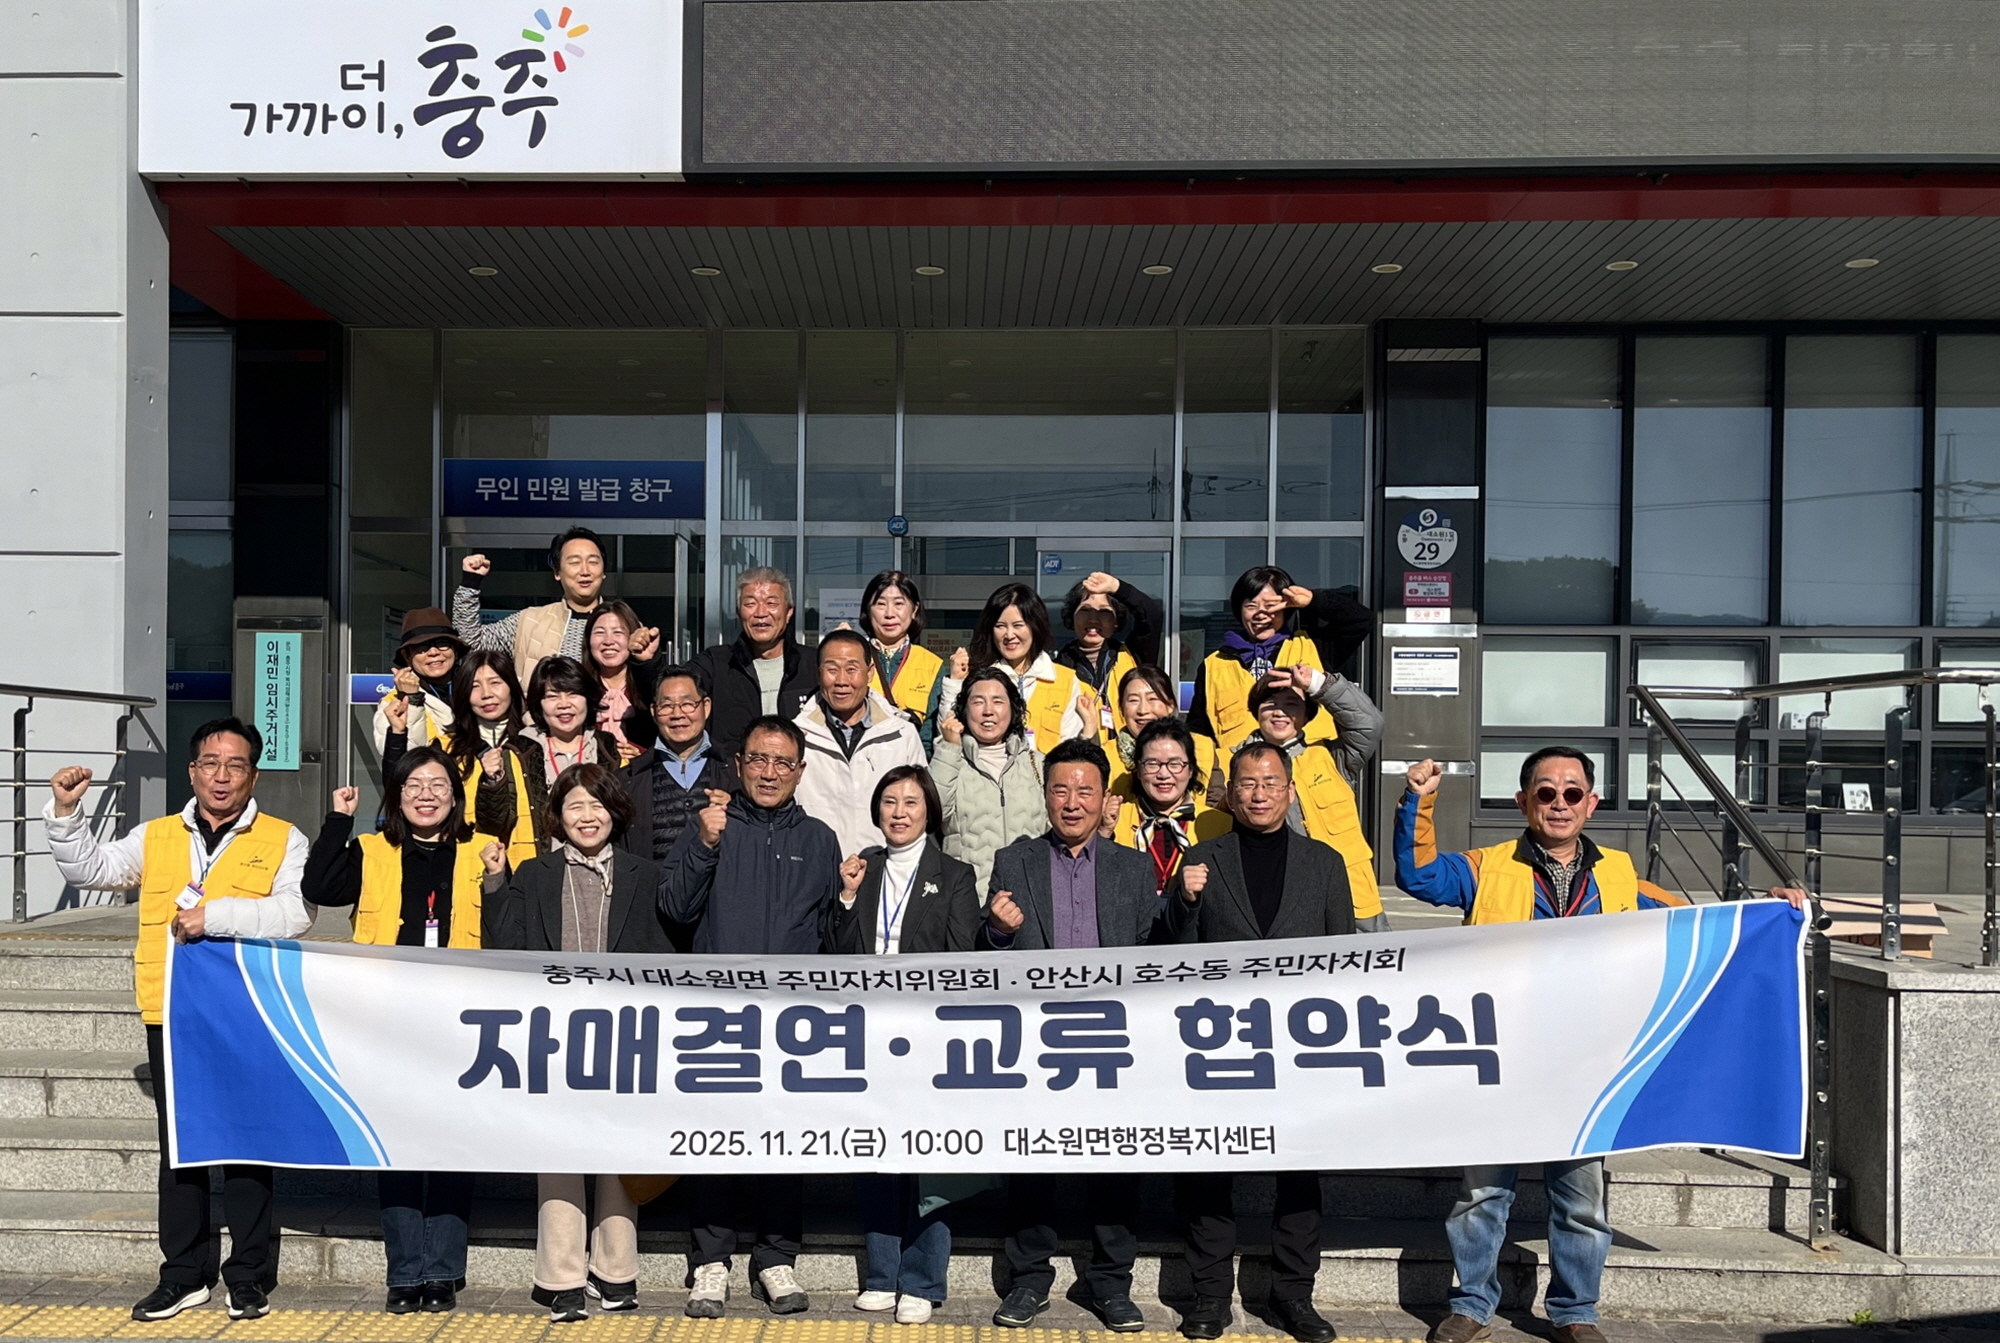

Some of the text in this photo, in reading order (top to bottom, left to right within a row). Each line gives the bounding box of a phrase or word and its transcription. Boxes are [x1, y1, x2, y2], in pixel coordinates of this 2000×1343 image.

[230, 25, 559, 159] 가까이, 충주
[340, 59, 385, 92] 더
[475, 477, 673, 502] 무인 민원 발급 창구
[1414, 542, 1440, 561] 29
[265, 640, 278, 761] 이재민 임시주거시설
[542, 963, 635, 986] 충주시
[642, 967, 768, 990] 대소원면
[777, 968, 999, 992] 주민자치위원회
[1026, 963, 1122, 990] 안산시
[1132, 958, 1232, 985] 호수동
[1239, 947, 1406, 979] 주민자치회
[1174, 992, 1501, 1091] 협약식
[901, 1128, 983, 1156] 10:00
[1004, 1125, 1276, 1157] 대소원면행정복지센터
